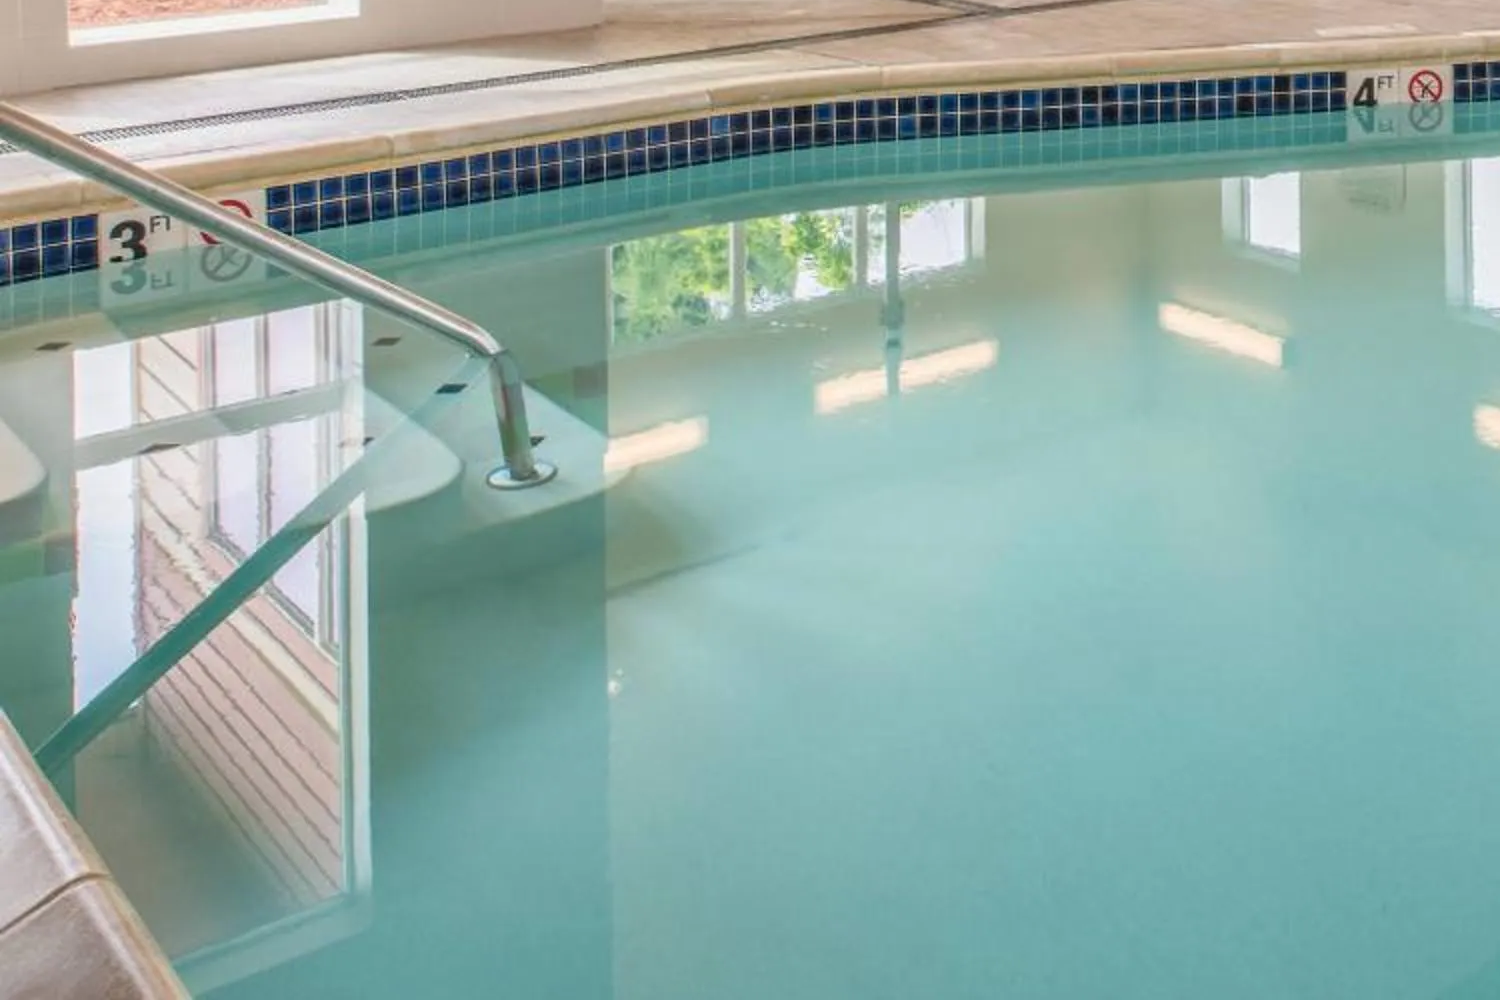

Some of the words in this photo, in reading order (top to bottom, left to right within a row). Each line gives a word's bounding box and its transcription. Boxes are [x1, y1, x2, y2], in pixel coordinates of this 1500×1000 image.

[1353, 78, 1377, 107] 4
[1378, 75, 1394, 88] FT
[109, 220, 147, 263] 3
[150, 215, 171, 233] FT
